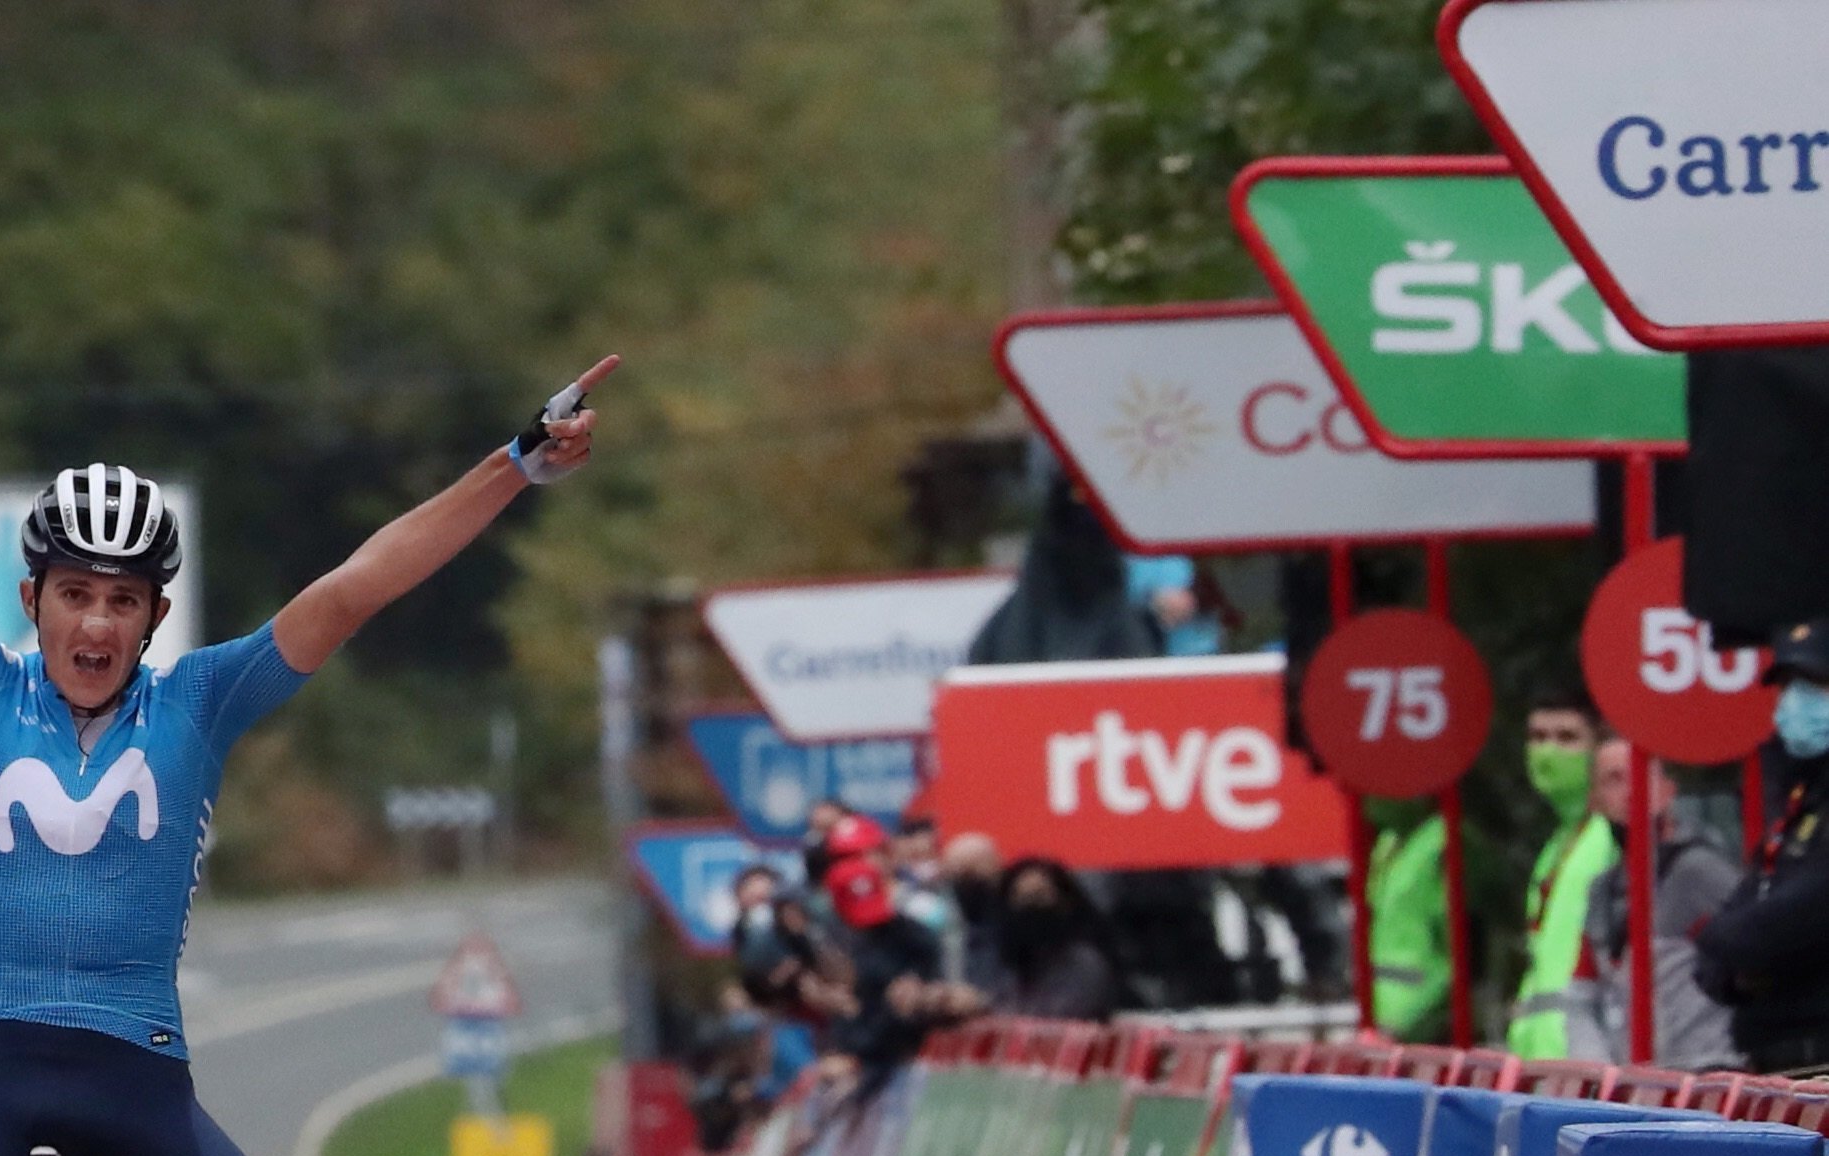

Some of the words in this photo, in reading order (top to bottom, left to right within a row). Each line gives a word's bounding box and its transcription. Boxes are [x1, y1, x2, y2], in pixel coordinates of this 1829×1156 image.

[1597, 114, 1829, 201] Carr
[1348, 667, 1450, 742] 75
[1044, 710, 1282, 829] rtve
